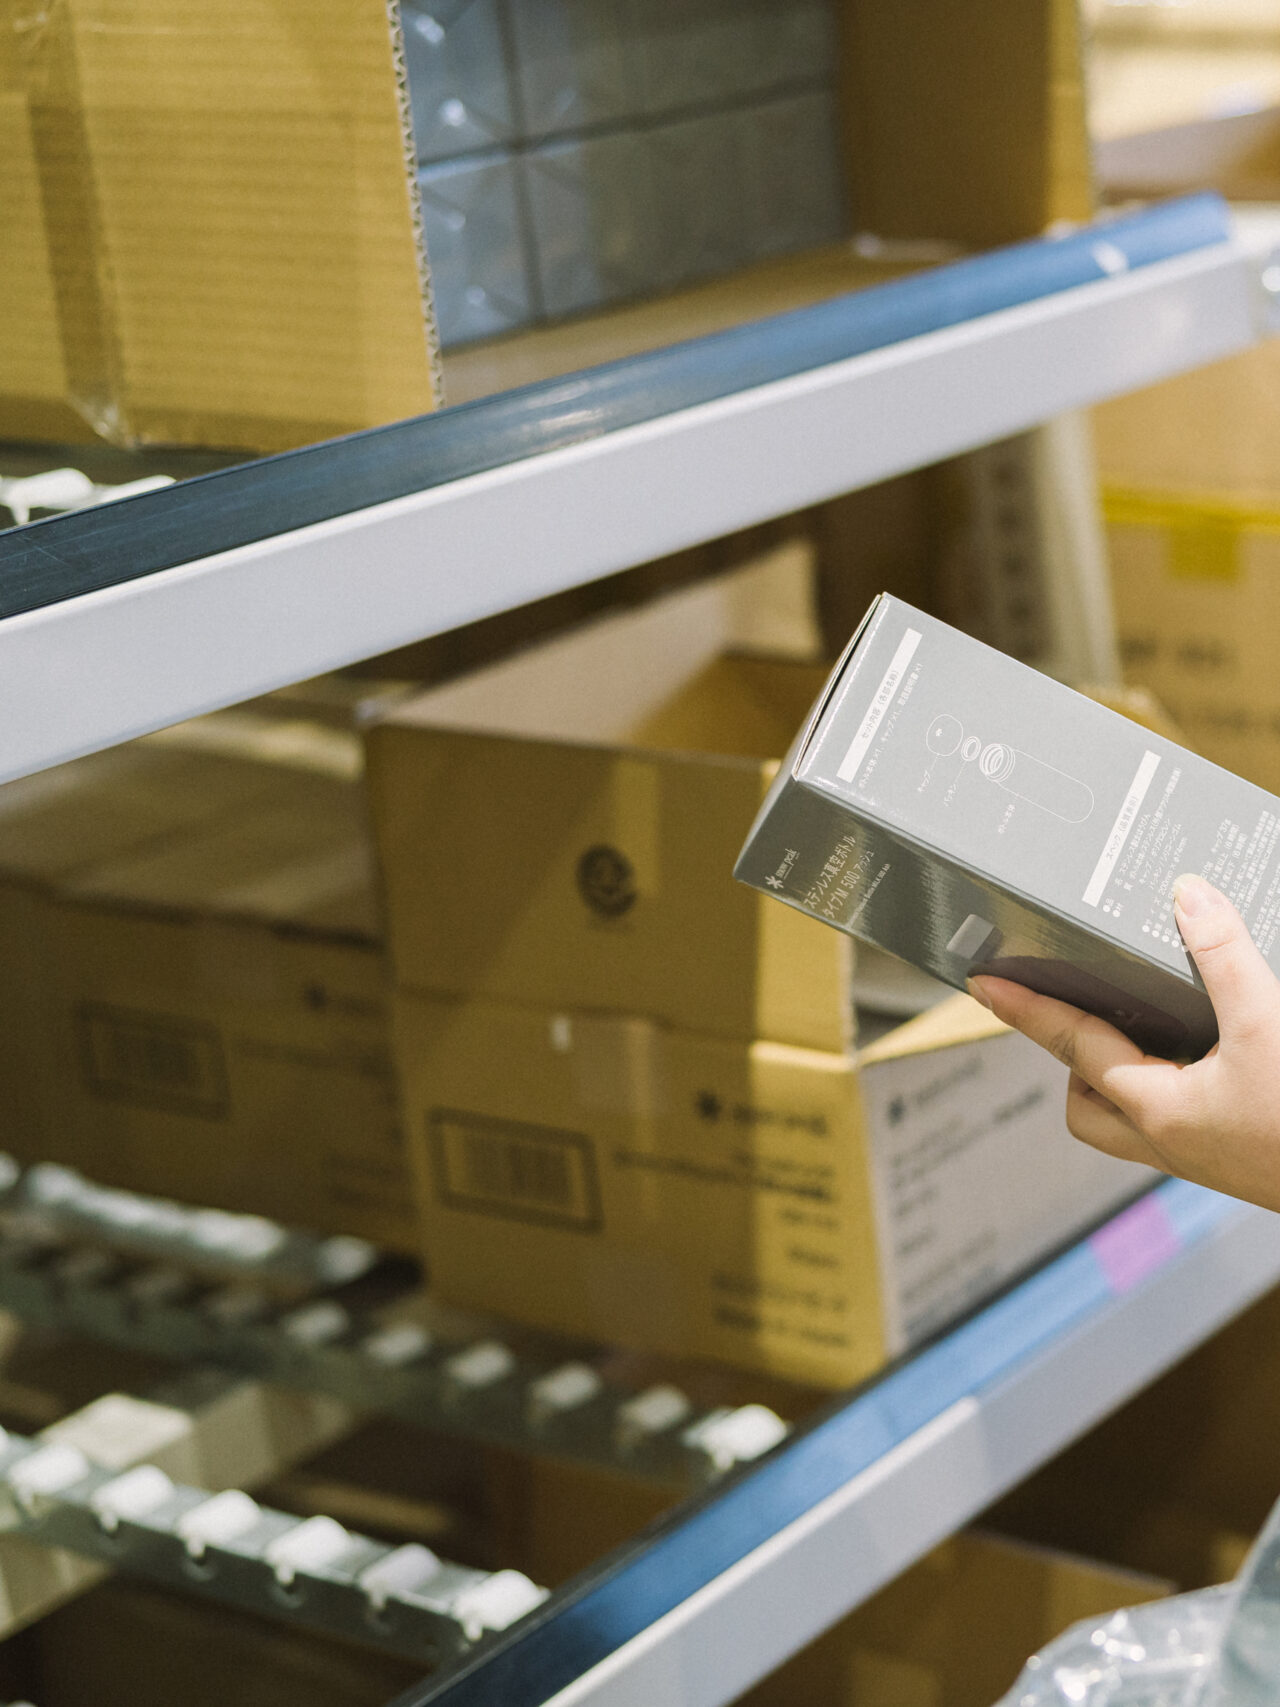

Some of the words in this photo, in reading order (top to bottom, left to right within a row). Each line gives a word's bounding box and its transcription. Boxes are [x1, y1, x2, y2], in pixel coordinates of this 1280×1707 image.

[803, 835, 857, 909] ステンレス真空ボトル
[840, 870, 861, 889] 500
[852, 850, 875, 873] アッシュ
